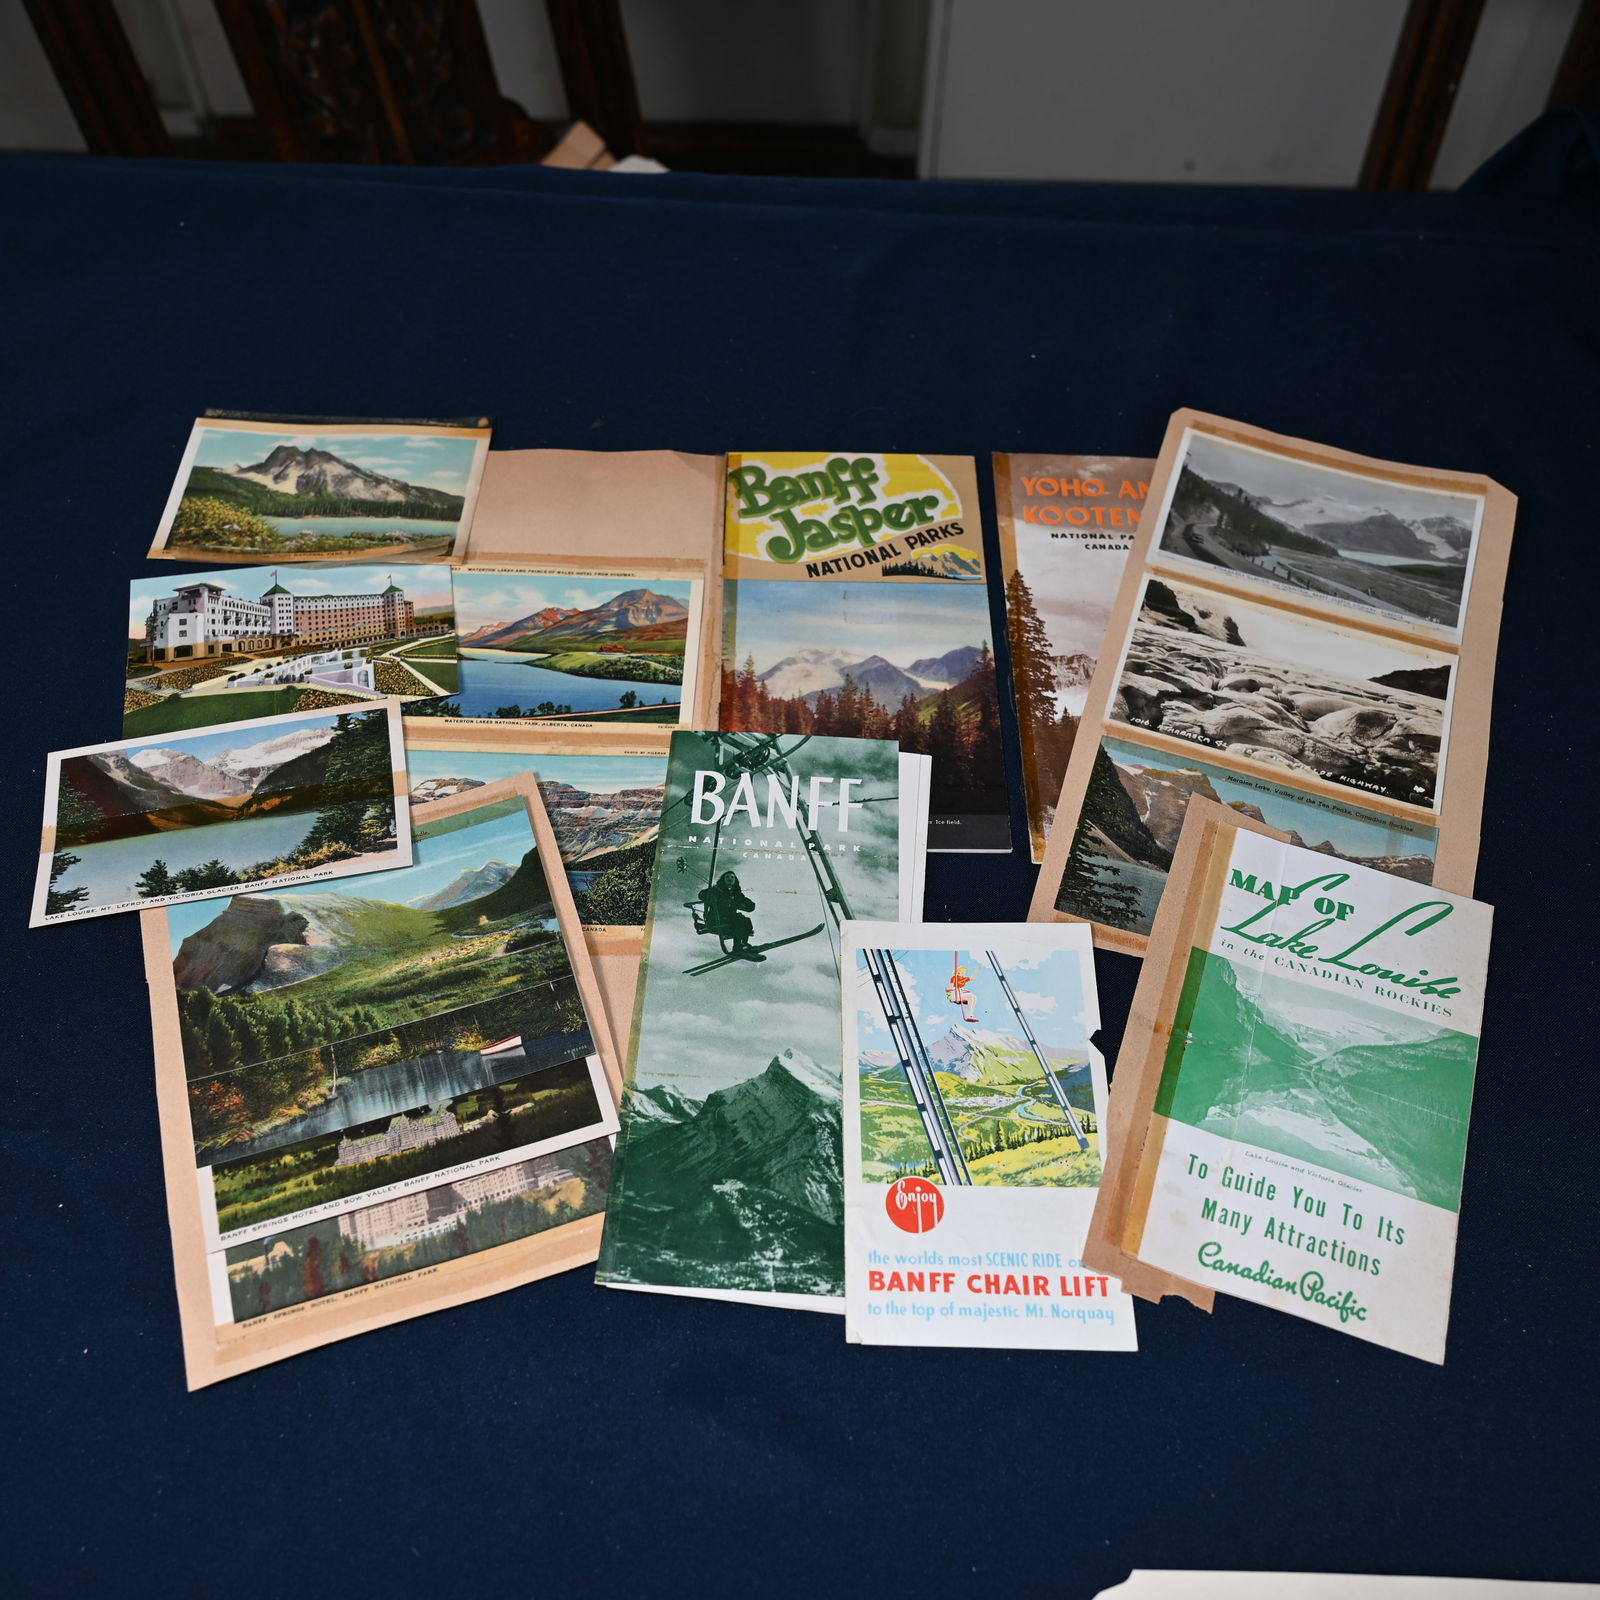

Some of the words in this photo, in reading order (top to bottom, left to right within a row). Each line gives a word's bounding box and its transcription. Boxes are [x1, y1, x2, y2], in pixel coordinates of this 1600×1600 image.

[728, 457, 879, 518] Banff
[1020, 476, 1105, 497] YOHO
[1118, 479, 1150, 499] AN
[766, 495, 940, 564] Jasper
[1023, 505, 1142, 527] KOOTEN
[805, 543, 902, 578] NATIONAL
[904, 522, 964, 550] PARKS
[1084, 543, 1130, 551] CANADA
[690, 770, 864, 833] BANFF
[1227, 775, 1253, 786] Moraine
[1254, 782, 1272, 793] Lake,
[1274, 788, 1295, 800] Valley
[1306, 797, 1317, 805] the
[1318, 800, 1330, 809] Ten
[1332, 804, 1353, 816] Peaks,
[1355, 811, 1387, 826] Canadian
[1388, 821, 1414, 832] Rockies
[688, 835, 796, 849] NATIONAL
[808, 842, 862, 852] PARK
[743, 852, 807, 861] CANADA
[44, 913, 65, 921] LAKE
[67, 907, 98, 918] LOUISE,
[116, 900, 146, 910] LEFROY
[168, 890, 204, 901] VICTORIA
[244, 880, 270, 888] BANFF
[272, 874, 310, 885] NATIONAL
[313, 870, 334, 878] PARK
[1229, 868, 1300, 905] MAP
[1313, 897, 1355, 921] OF
[1318, 901, 1461, 999] Louise
[1221, 938, 1234, 950] in
[1243, 947, 1266, 961] the
[1274, 956, 1365, 989] CANADIAN
[1374, 985, 1453, 1017] ROCKIES
[220, 1229, 249, 1241] BANFF
[252, 1217, 289, 1232] SPRINGS
[292, 1208, 319, 1221] HOTEL
[322, 1201, 341, 1211] AND
[343, 1195, 363, 1205] BOW
[403, 1175, 431, 1188] BANFF
[434, 1163, 476, 1180] NATIONAL
[479, 1155, 501, 1167] PARK
[1245, 1150, 1262, 1160] Lake
[1265, 1156, 1288, 1168] Louise
[1290, 1165, 1305, 1173] and
[1307, 1169, 1335, 1184] Victoria
[1337, 1180, 1363, 1193] Glacier
[895, 1180, 937, 1233] Enjoy
[1187, 1153, 1209, 1180] To
[1221, 1165, 1277, 1201] Guide
[1293, 1186, 1326, 1218] You
[1342, 1203, 1363, 1231] To
[1377, 1216, 1405, 1246] Its
[867, 1250, 890, 1265] the
[948, 1254, 983, 1267] most
[986, 1252, 1029, 1267] SCENIC
[1032, 1253, 1062, 1268] RIDE
[1201, 1197, 1253, 1236] Many
[1264, 1217, 1381, 1276] Attractions
[242, 1317, 268, 1328] BANFF
[273, 1307, 305, 1320] SPRINGS
[343, 1287, 369, 1299] BANFF
[374, 1275, 413, 1289] NATIONAL
[418, 1267, 439, 1278] PARK
[868, 1270, 956, 1293] BANFF
[966, 1273, 1051, 1296] CHAIR
[1059, 1275, 1109, 1297] LIFT
[1197, 1241, 1297, 1295] Canadian
[1299, 1270, 1367, 1323] Pacific
[868, 1303, 882, 1315] to
[885, 1301, 907, 1316] the
[911, 1303, 935, 1321] top
[940, 1301, 955, 1317] of
[958, 1303, 1019, 1322] majestic
[1025, 1304, 1047, 1319] Mt.
[1051, 1303, 1115, 1326] Norquay
